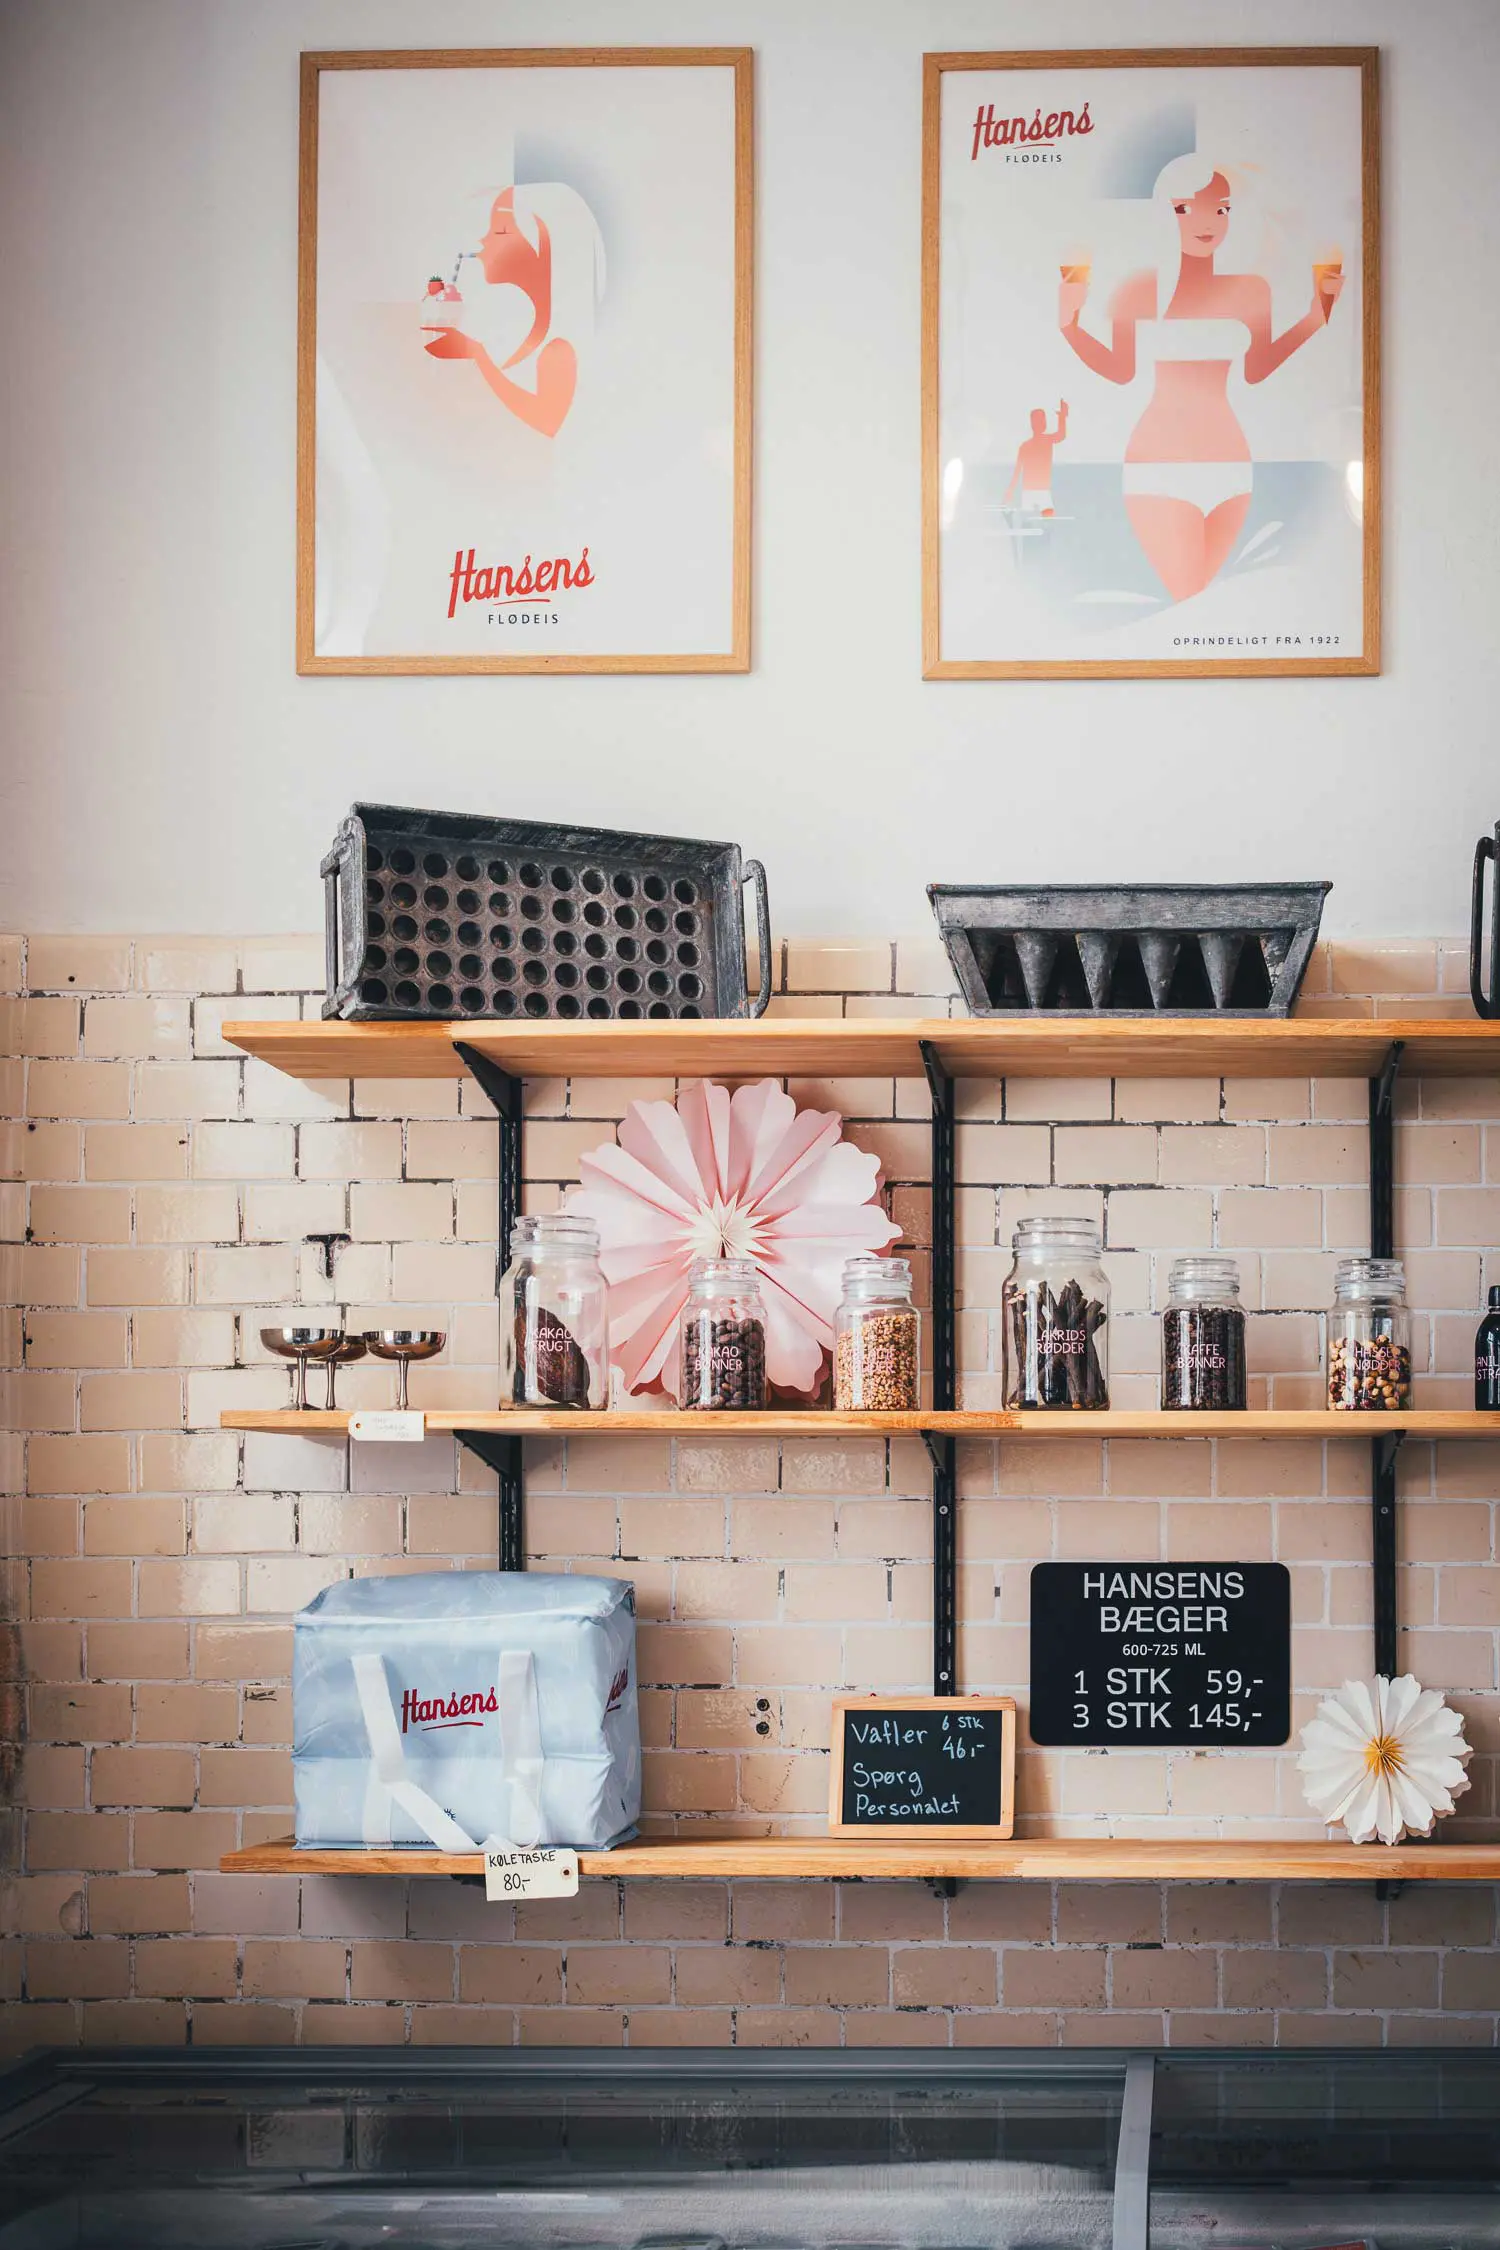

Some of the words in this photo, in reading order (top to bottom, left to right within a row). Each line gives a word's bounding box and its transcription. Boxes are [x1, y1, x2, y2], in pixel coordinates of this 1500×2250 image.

[971, 102, 1095, 161] Hansens
[1006, 154, 1063, 163] FLØDEIS
[447, 547, 596, 618] Hansens
[488, 614, 559, 625] FLØDEIS
[1173, 636, 1268, 646] OPRINDELIGT
[1276, 636, 1302, 645] FRA
[1310, 636, 1341, 644] 1922
[698, 1346, 739, 1358] KAKAO
[1355, 1346, 1398, 1359] HASSE
[695, 1358, 743, 1371] BØNNER
[1177, 1356, 1226, 1369] BØNNER
[1353, 1359, 1401, 1371] NØDDER
[1083, 1571, 1245, 1599] HANSENS
[1100, 1605, 1228, 1633] BÆGER
[1122, 1643, 1178, 1656] 600-725
[1184, 1643, 1206, 1656] ML
[1074, 1670, 1089, 1694] 1
[1106, 1667, 1172, 1695] STK
[1206, 1669, 1264, 1698] 59,-
[401, 1686, 499, 1734] Hansens
[1073, 1703, 1090, 1728] 3
[1106, 1701, 1172, 1729] STK
[1188, 1703, 1262, 1732] 145,-
[942, 1715, 950, 1731] 6
[957, 1716, 984, 1729] STK
[851, 1719, 928, 1746] Vafler
[853, 1762, 923, 1797] Spørg
[856, 1793, 960, 1817] Personalet
[489, 1850, 556, 1868] KØLETASKE
[503, 1873, 531, 1892] 80,-
